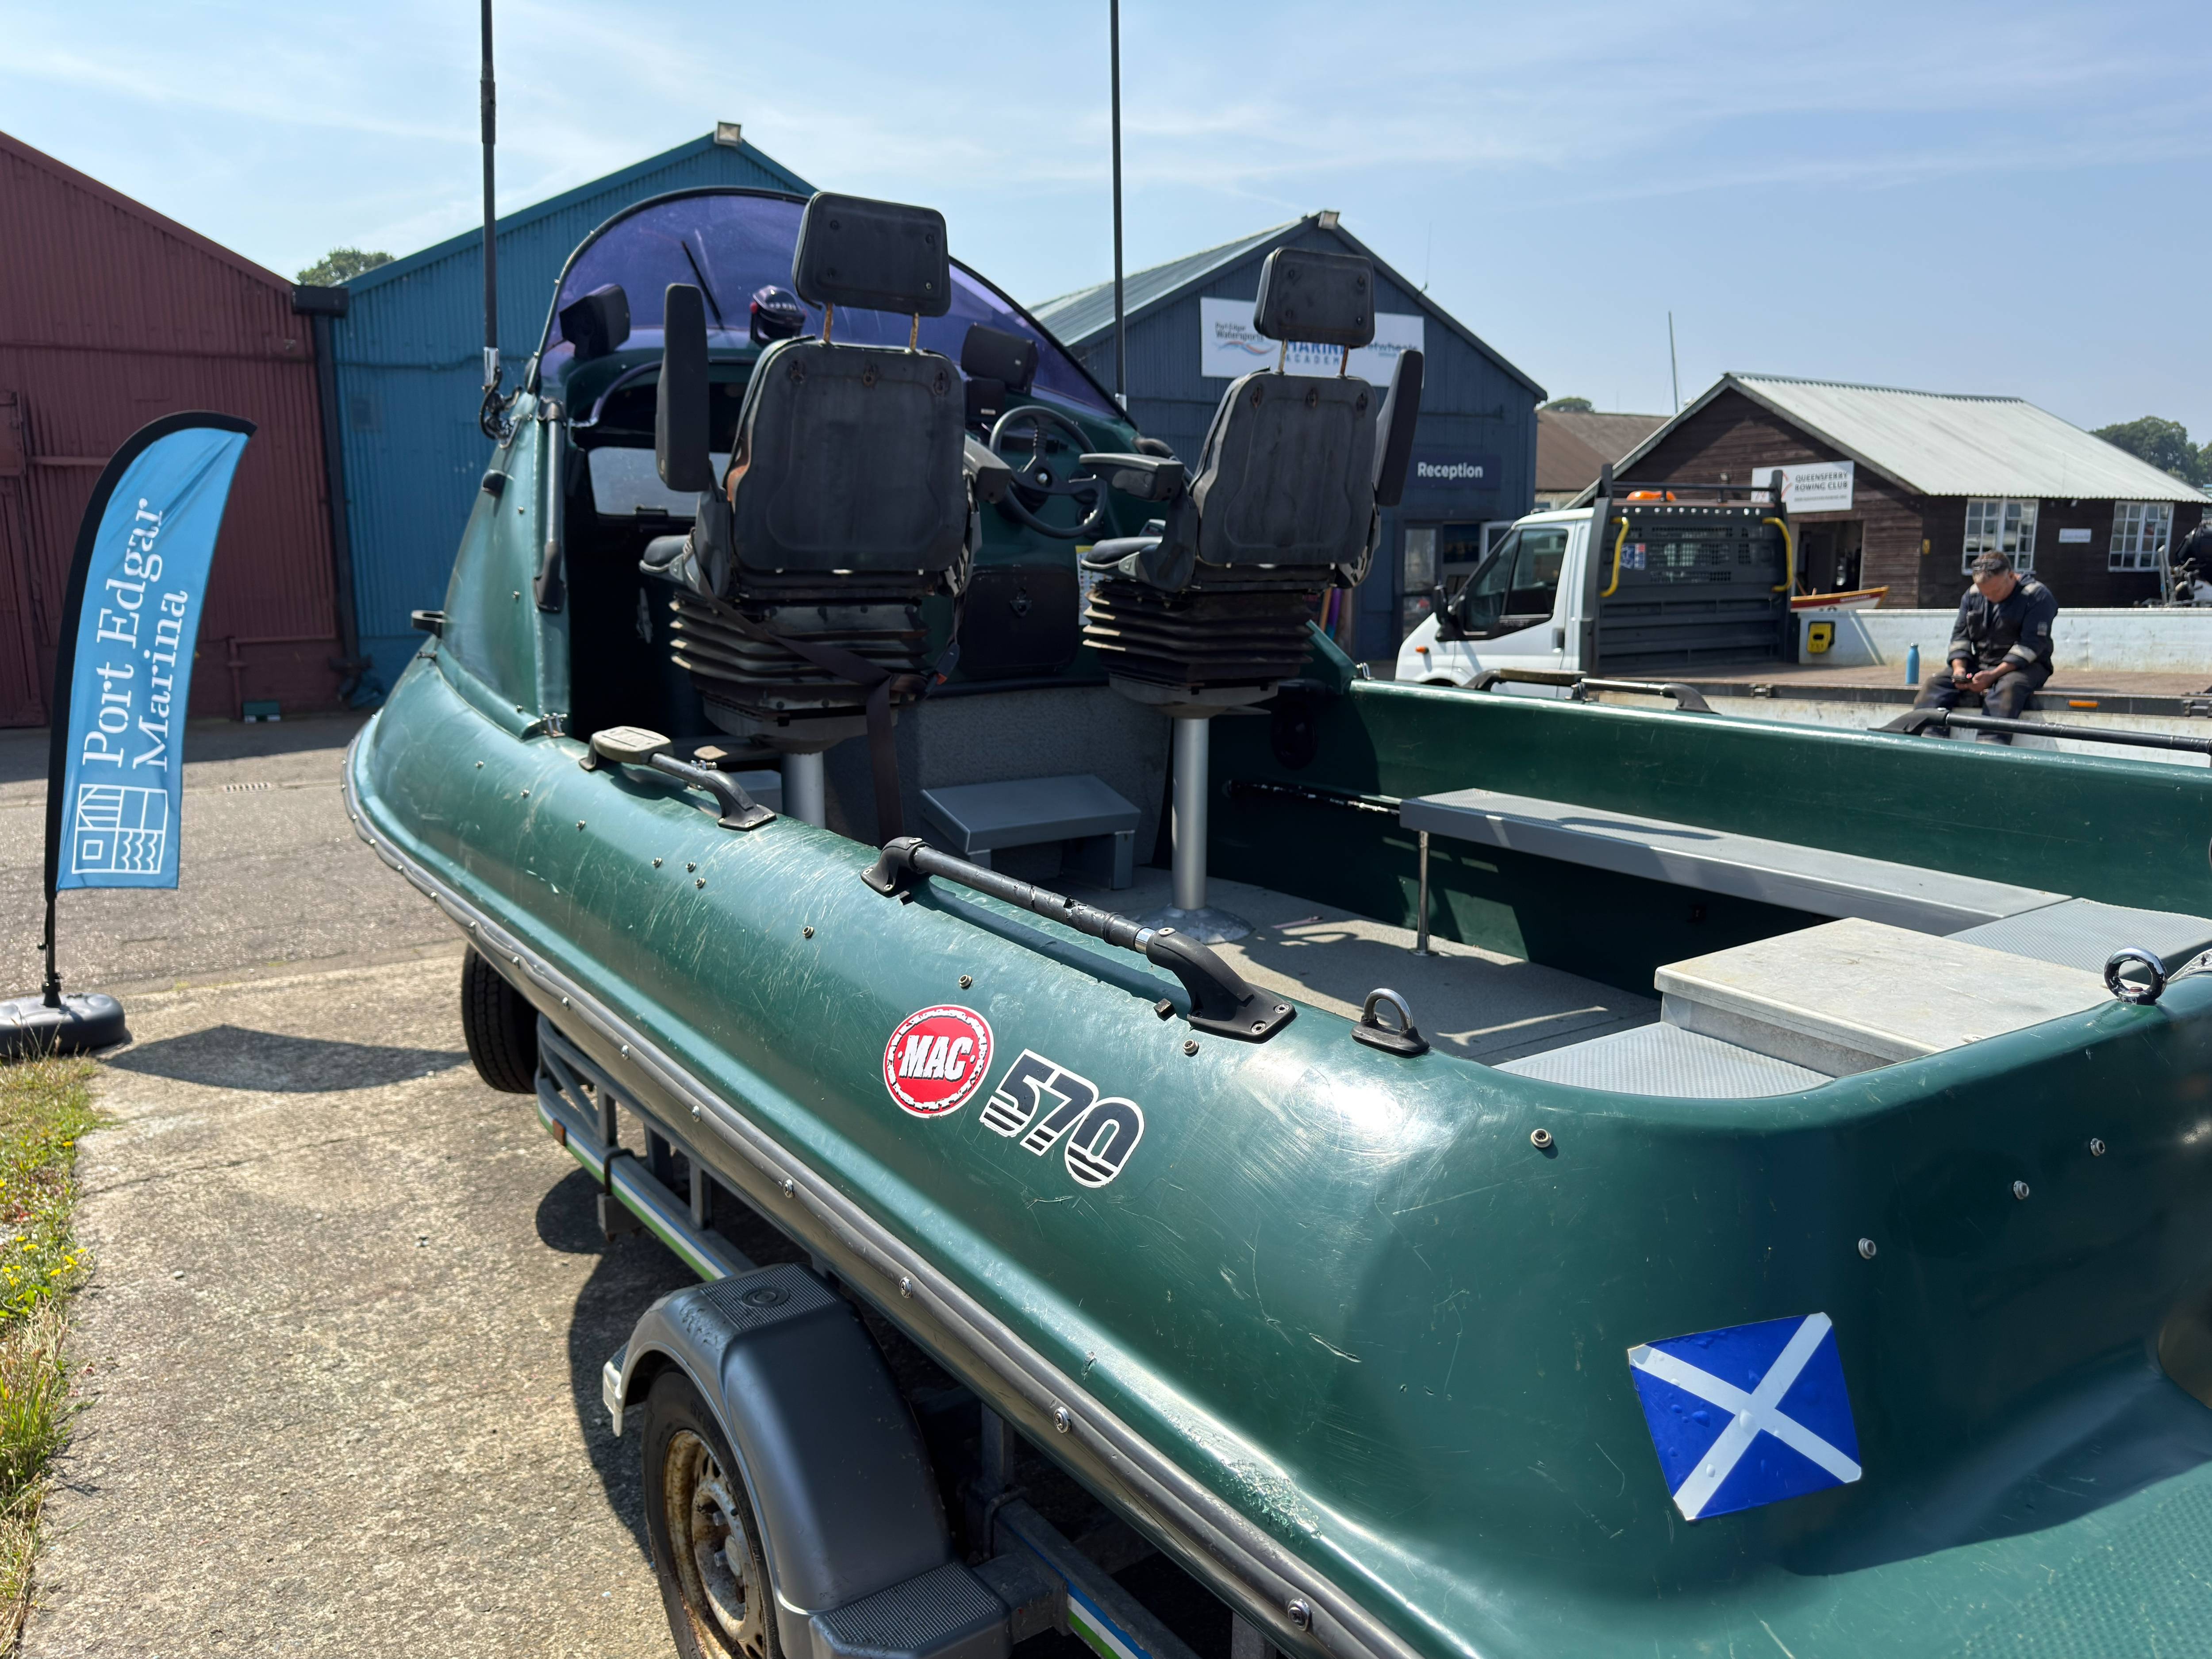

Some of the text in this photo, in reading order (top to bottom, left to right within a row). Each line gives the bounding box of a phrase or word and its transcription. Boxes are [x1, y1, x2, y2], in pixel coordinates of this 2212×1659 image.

[1288, 341, 1345, 354] MARIN
[1286, 353, 1340, 365] ACADEM
[1417, 461, 1483, 480] Reception
[1795, 471, 1848, 483] QUEENSFERRY
[1795, 480, 1848, 492] ROWING CLUB
[83, 497, 164, 768] Port Edgar
[133, 590, 189, 772] Marina
[898, 1035, 974, 1082] MAC
[979, 1048, 1145, 1188] 570
